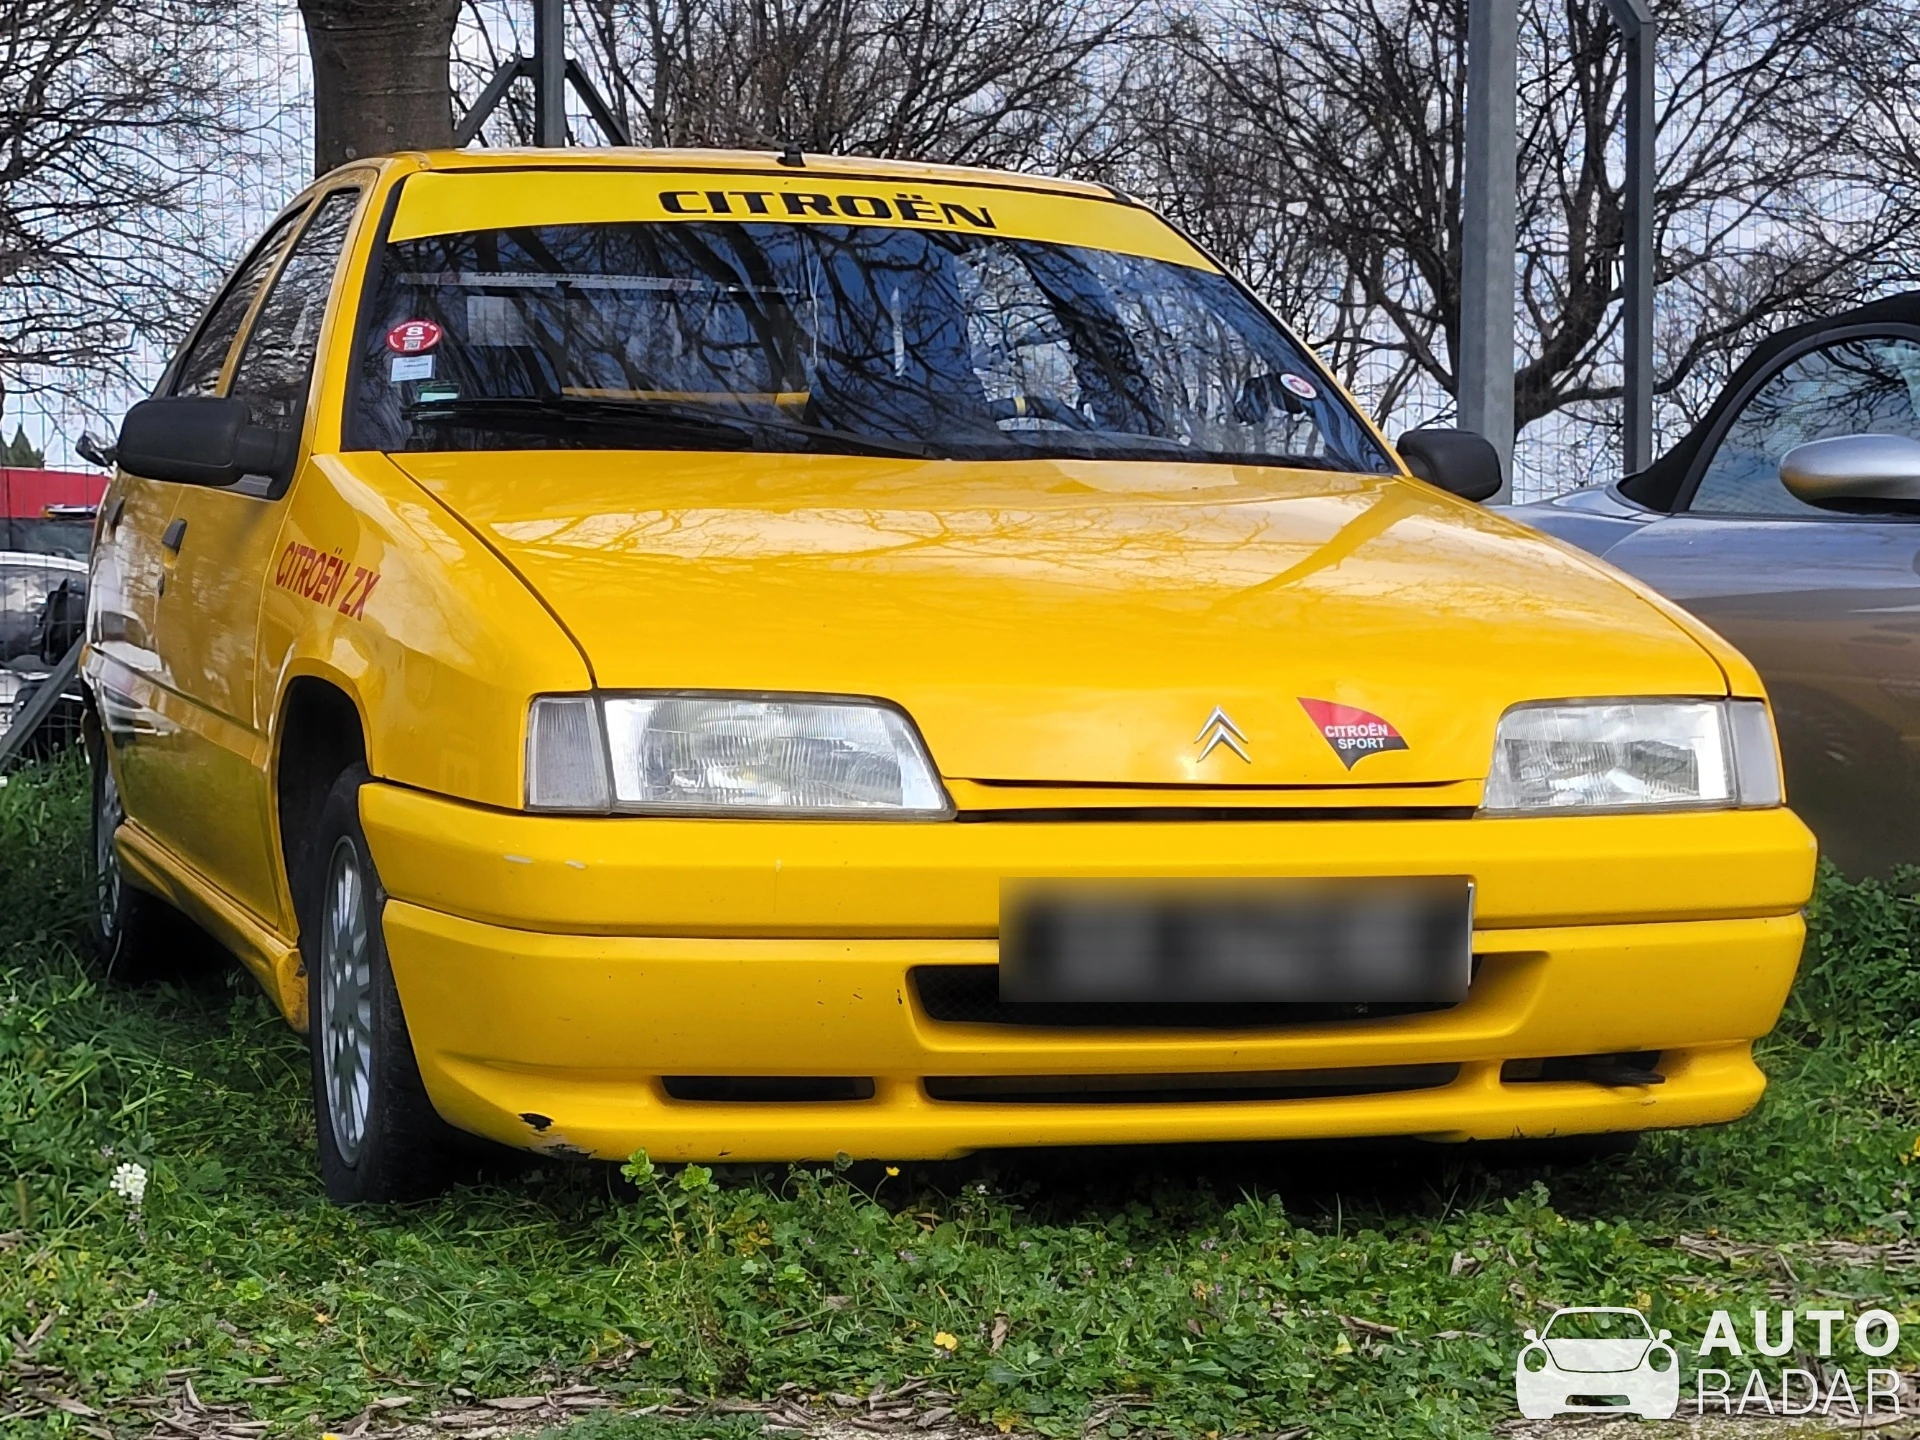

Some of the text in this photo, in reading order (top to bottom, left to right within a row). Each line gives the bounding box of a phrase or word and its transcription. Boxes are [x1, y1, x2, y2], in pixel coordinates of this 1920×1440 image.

[658, 191, 997, 230] CITROËN
[275, 541, 381, 621] CITROËN ZX
[1324, 723, 1389, 738] CITROËN
[1337, 737, 1385, 749] SPORT
